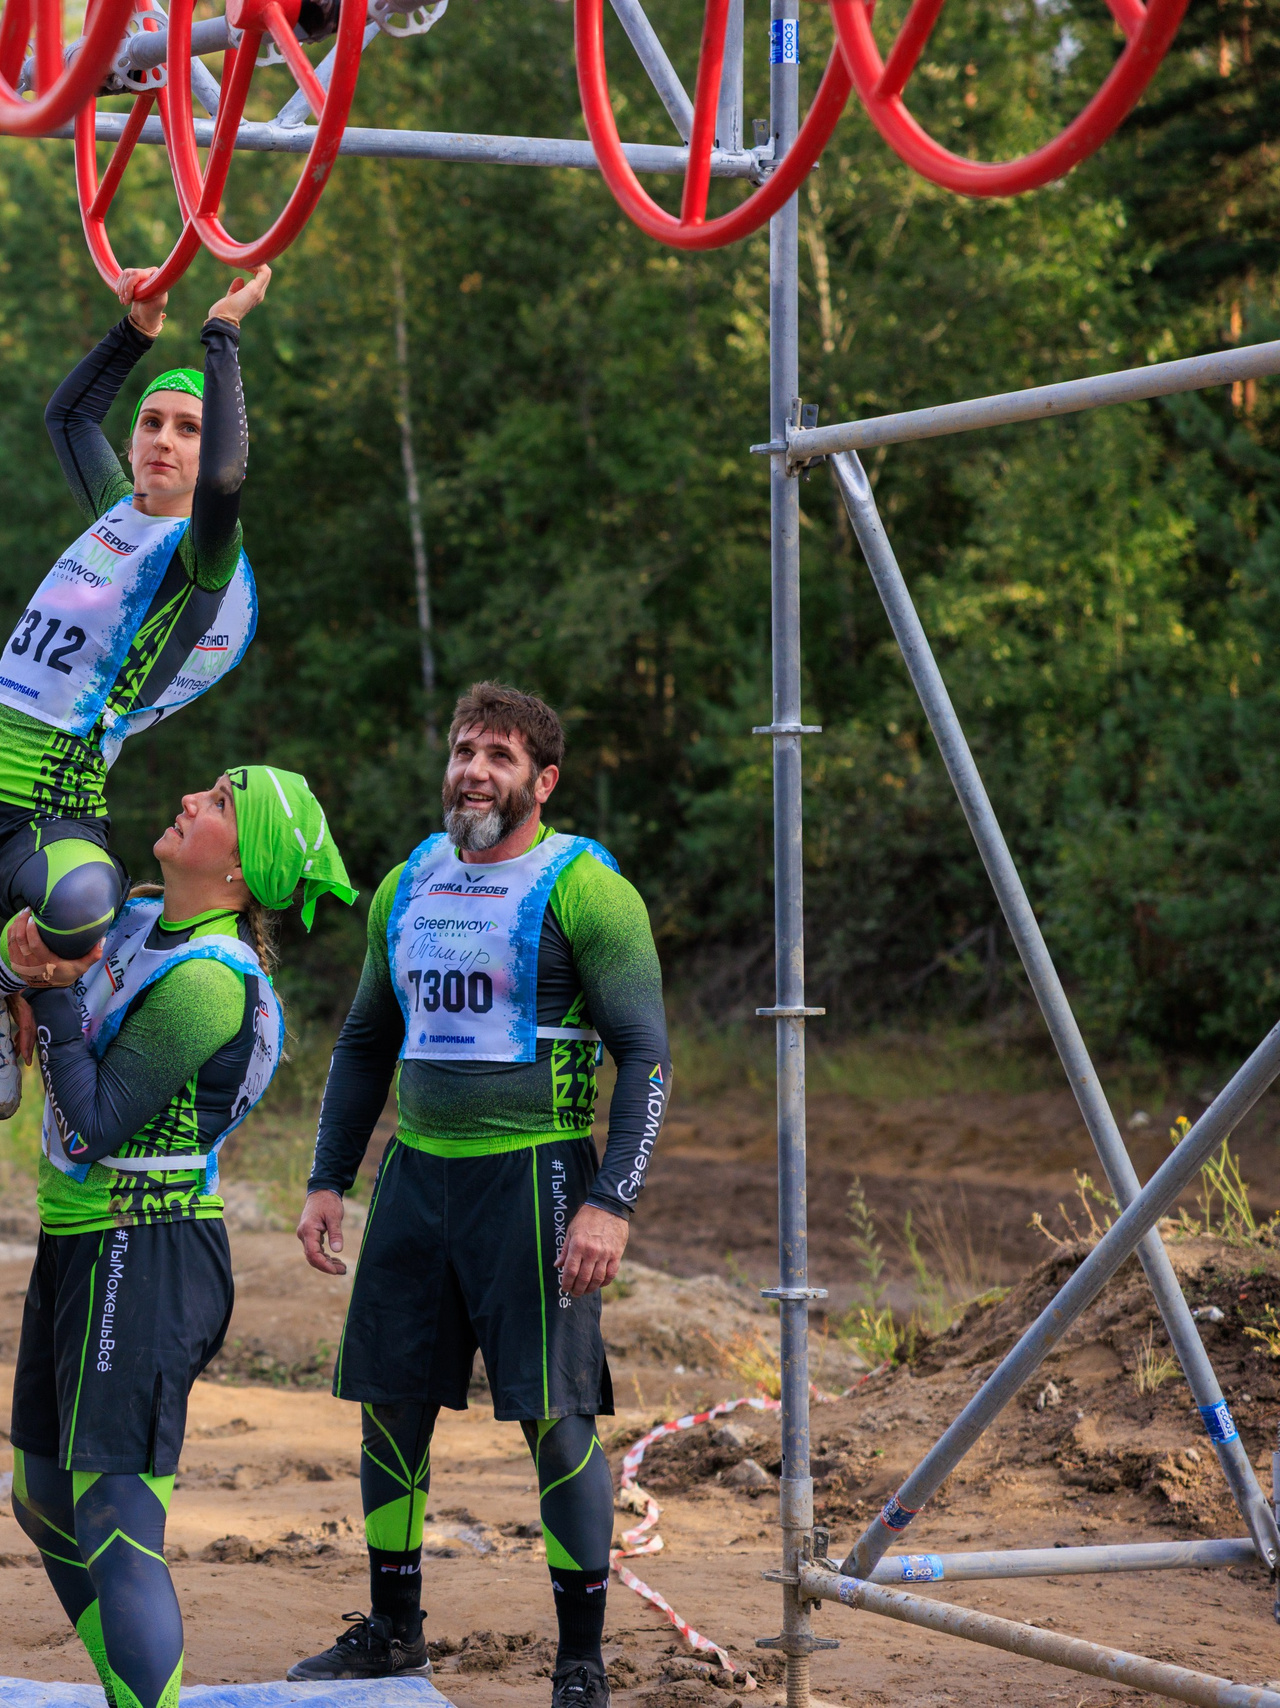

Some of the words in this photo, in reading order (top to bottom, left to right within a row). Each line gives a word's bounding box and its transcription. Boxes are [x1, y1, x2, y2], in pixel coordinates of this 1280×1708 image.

[784, 23, 794, 59] СОЮЗ
[429, 883, 462, 893] ГОНКА
[465, 885, 508, 895] ГЕРОЕВ
[413, 916, 488, 934] Greenway
[407, 969, 494, 1014] 7300
[429, 1034, 476, 1044] ГАЗПРОМБАНК
[97, 1229, 129, 1373] #ТыМожешьВсё
